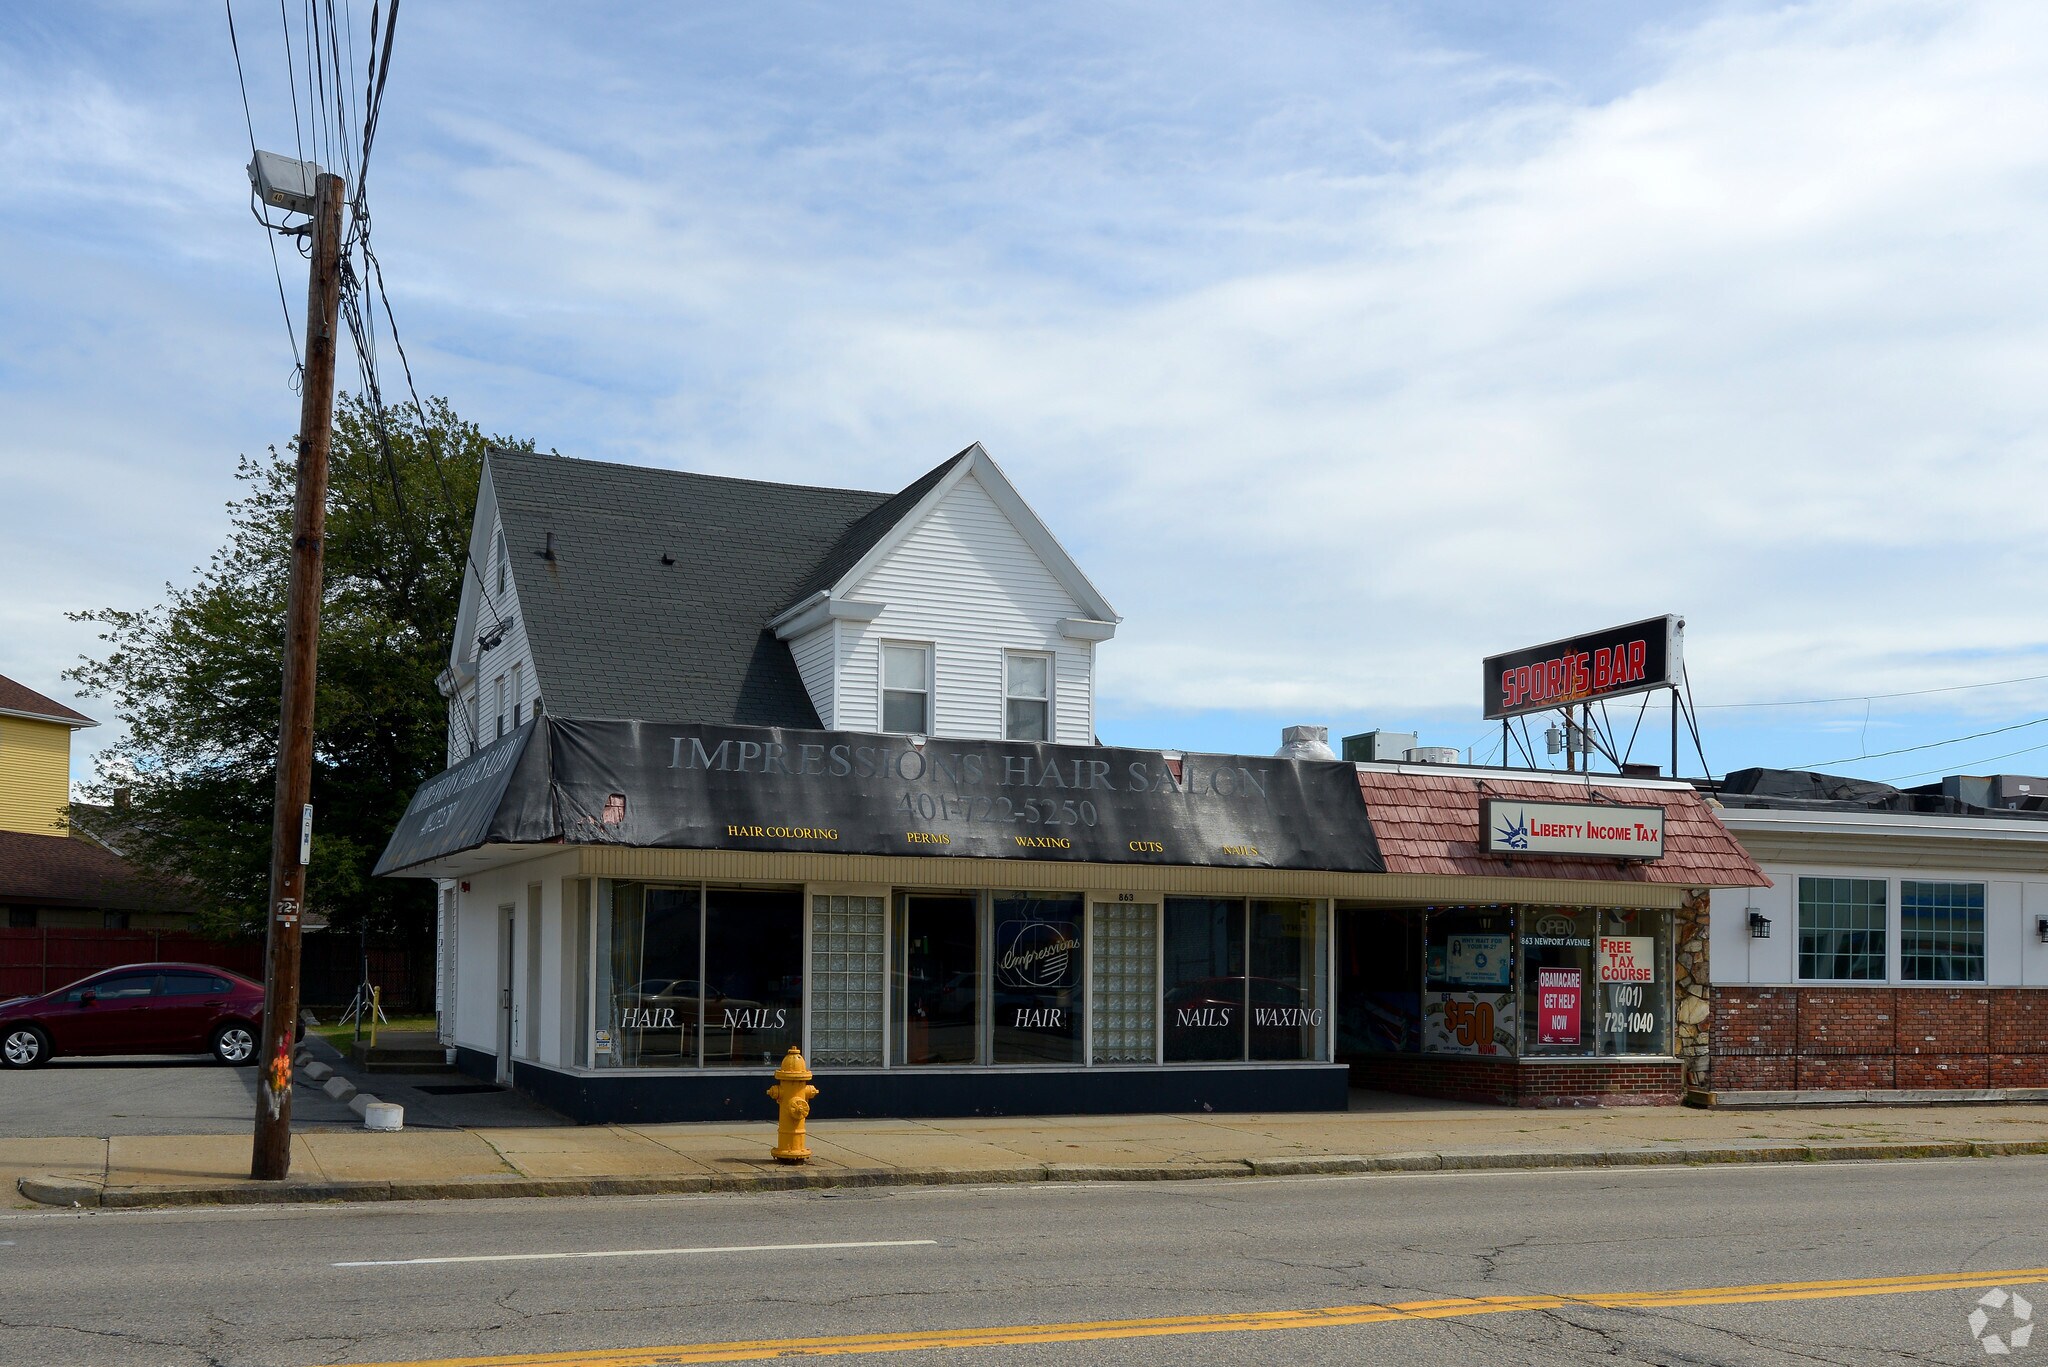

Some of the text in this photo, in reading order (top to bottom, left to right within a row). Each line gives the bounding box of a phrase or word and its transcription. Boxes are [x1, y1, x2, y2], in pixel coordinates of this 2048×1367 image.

[1502, 640, 1646, 707] SPORTS BAR
[667, 737, 1269, 798] IMPRESSIONS HAIR SALON
[896, 792, 1098, 827] 401-722-5250
[728, 825, 839, 840] HAIR COLORING
[907, 831, 950, 845] PERMS
[1015, 836, 1071, 849] WAXING
[1129, 841, 1164, 853] CUTS
[1222, 844, 1258, 857] NAILS
[1118, 893, 1134, 902] 863
[1540, 919, 1572, 935] OPEN
[1521, 937, 1591, 947] 863 NEWPORT AVENUE
[1600, 938, 1632, 954] FREE
[1609, 954, 1635, 968] TAX
[1540, 972, 1580, 988] OBAMACARE
[1601, 965, 1651, 981] COURSE
[1441, 992, 1451, 1002] GET
[1544, 993, 1576, 1009] GET HELP
[1615, 986, 1643, 1008] (401)
[621, 1008, 676, 1028] HAIR
[722, 1008, 786, 1029] NAILS
[1015, 1008, 1061, 1028] HAIR
[1176, 1007, 1228, 1027] NAILS
[1255, 1008, 1323, 1027] WAXING
[1444, 998, 1494, 1047] $50
[1551, 1015, 1567, 1030] NOW
[1604, 1012, 1654, 1033] 729-1040
[1478, 1044, 1497, 1055] NOW!
